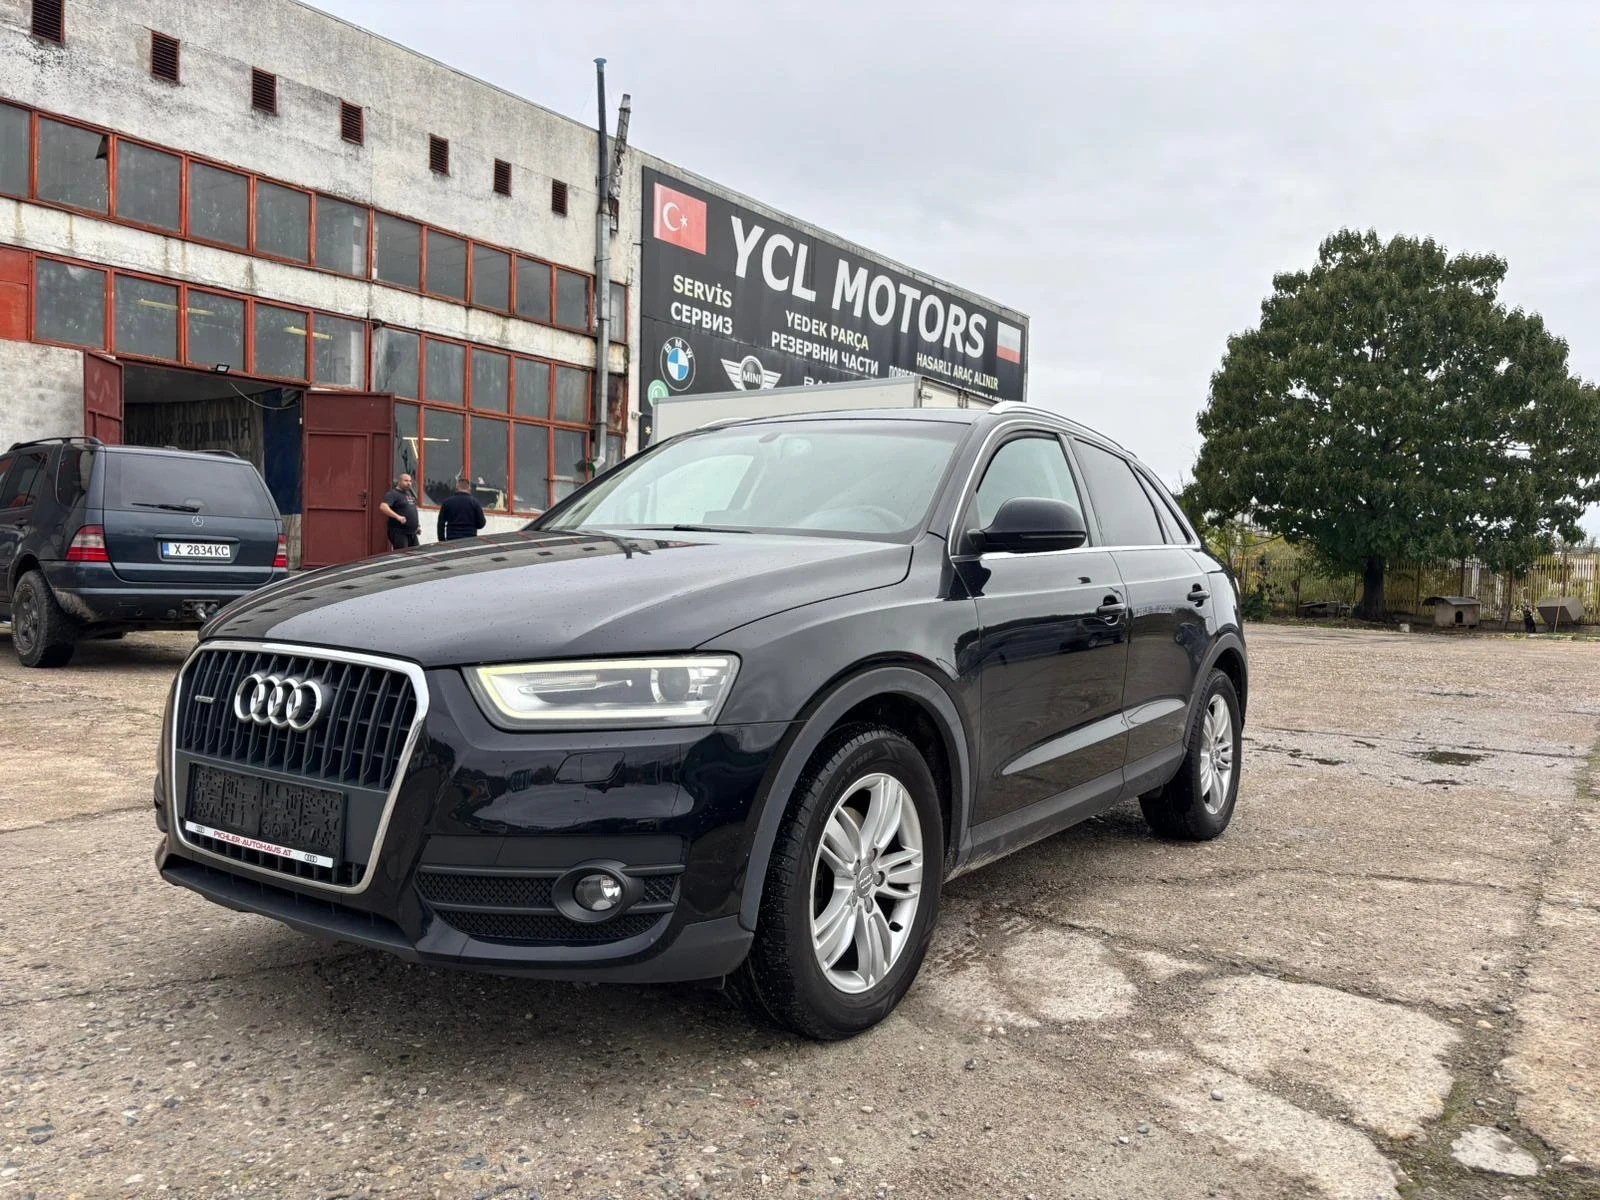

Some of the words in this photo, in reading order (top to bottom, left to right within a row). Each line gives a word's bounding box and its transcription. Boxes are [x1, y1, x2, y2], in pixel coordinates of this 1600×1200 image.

[731, 216, 816, 302] YCL
[832, 259, 987, 358] MOTORS
[671, 301, 733, 335] СЕРВИЗ
[785, 310, 828, 338] YEDEK
[831, 325, 869, 352] PARÇA
[771, 331, 838, 365] РЕЗЕРВНИ
[841, 351, 879, 376] ЧАСТИ
[916, 352, 952, 376] HASARLI
[952, 364, 974, 385] ARAÇ
[974, 371, 999, 390] ALINIR
[742, 370, 761, 385] MINI
